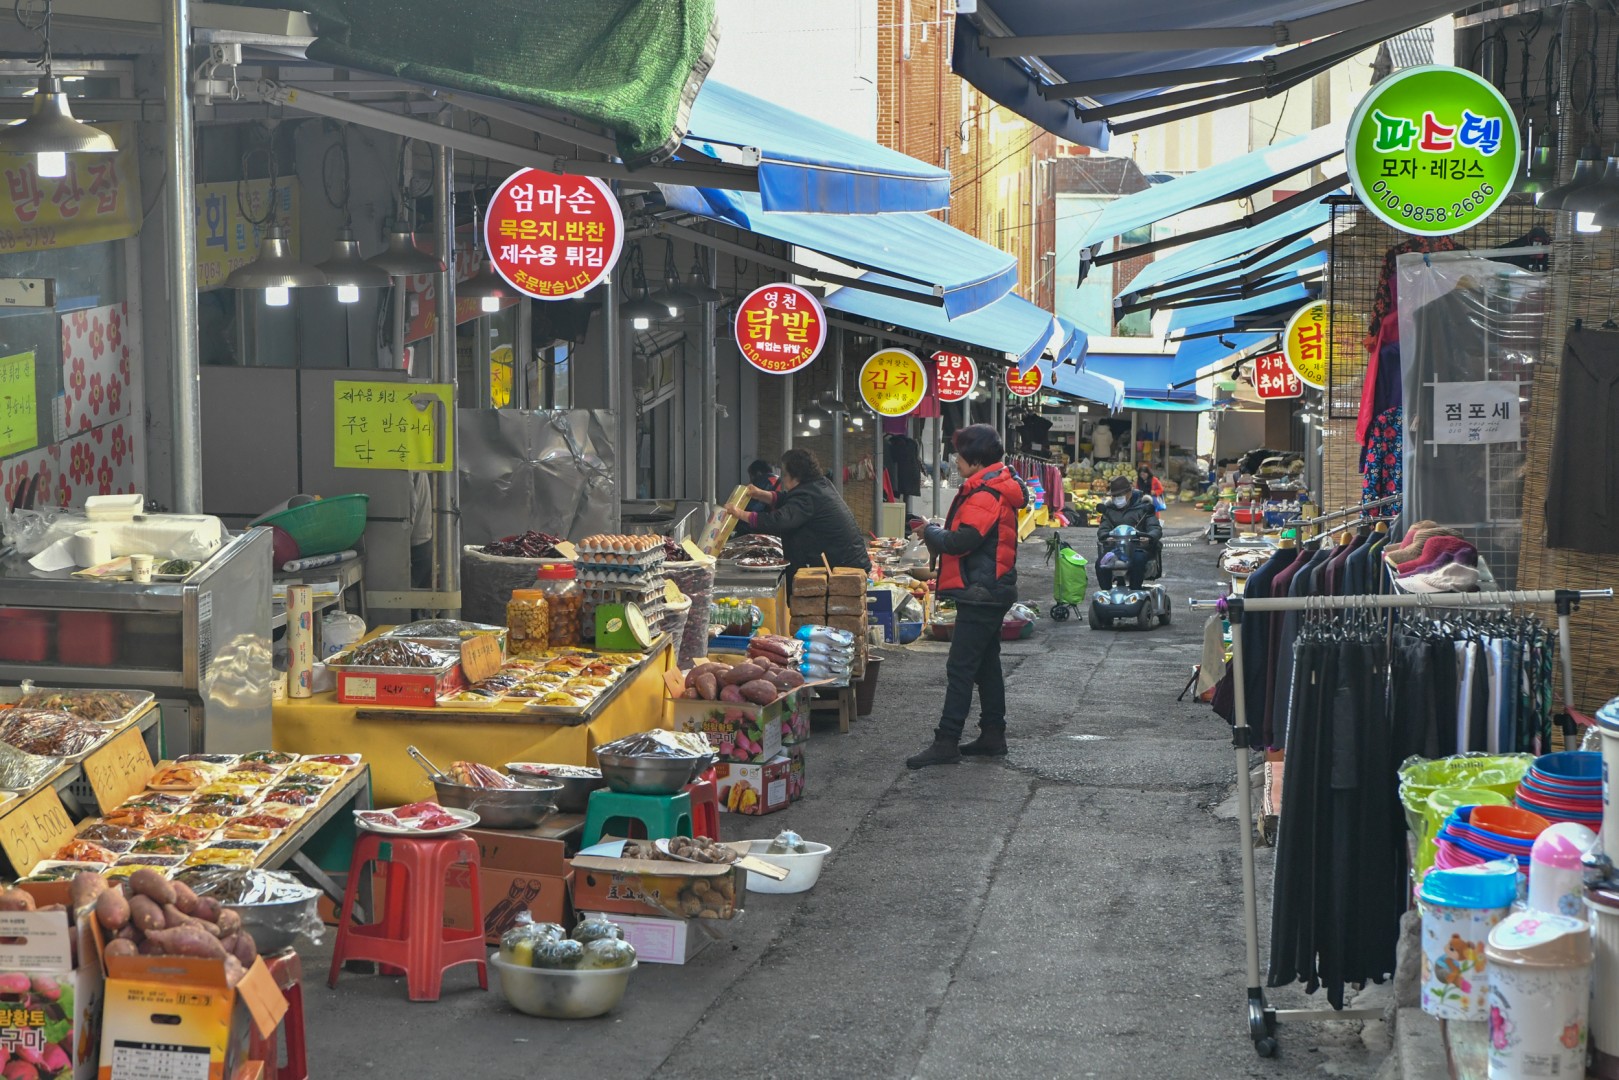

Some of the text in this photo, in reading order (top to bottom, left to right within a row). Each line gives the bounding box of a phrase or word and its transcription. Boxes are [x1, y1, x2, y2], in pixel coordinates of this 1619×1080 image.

[1371, 108, 1502, 157] 파스텔
[509, 183, 596, 215] 엄마손
[500, 244, 558, 266] 제수용
[565, 246, 604, 267] 튀김
[514, 269, 592, 295] 주문받습니다
[764, 291, 797, 310] 영천
[745, 307, 816, 343] 닭발
[938, 355, 962, 368] 밀양
[1261, 356, 1289, 370] 가마
[866, 369, 917, 393] 김치
[1259, 373, 1299, 395] 추어탕
[339, 388, 373, 403] 제수용
[1445, 402, 1510, 421] 점포세
[0, 1027, 48, 1053] 구마
